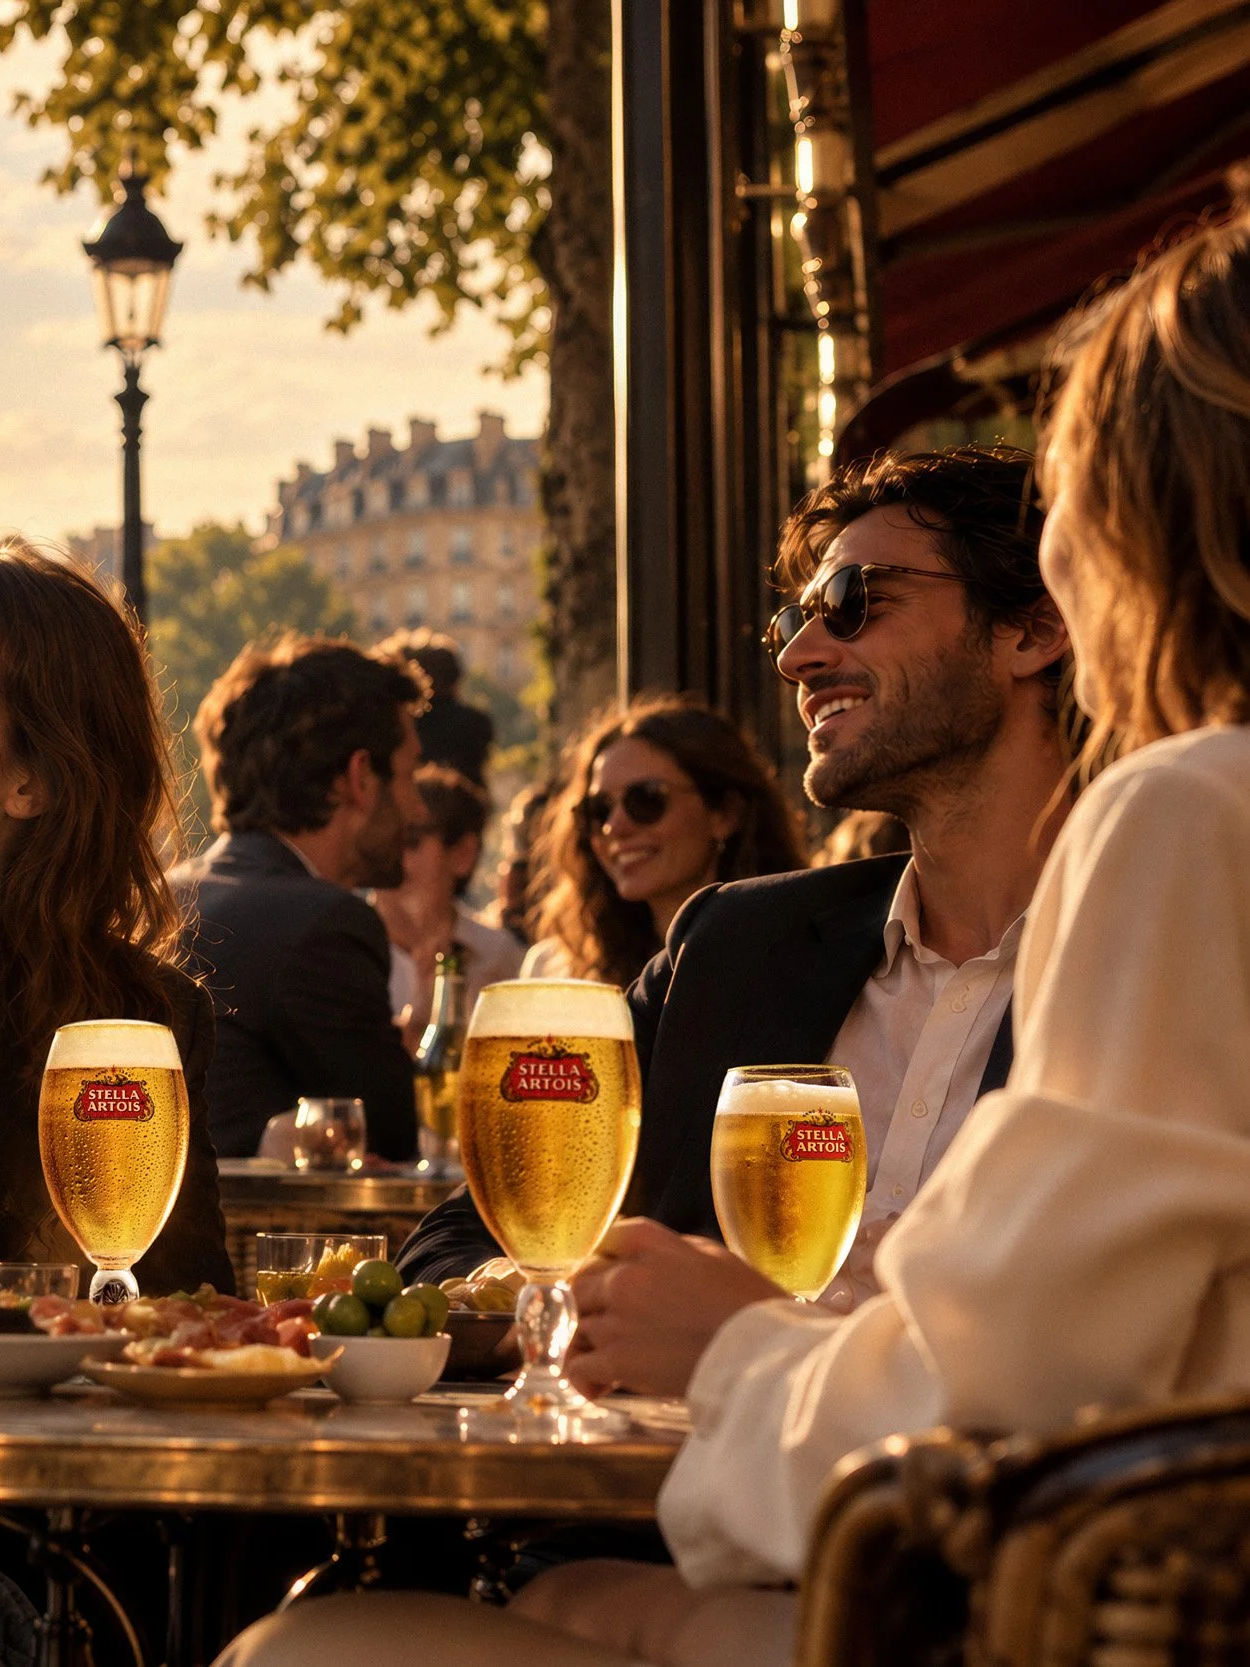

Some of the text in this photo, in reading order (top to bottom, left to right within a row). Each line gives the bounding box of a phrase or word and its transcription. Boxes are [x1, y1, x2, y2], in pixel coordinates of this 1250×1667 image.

[518, 1063, 580, 1076] STELLA
[517, 1078, 582, 1091] ARTOIS
[88, 1089, 140, 1100] STELLA
[87, 1101, 141, 1112] ARTOIS
[796, 1129, 845, 1141] STELLA
[796, 1142, 846, 1153] ARTOIS
